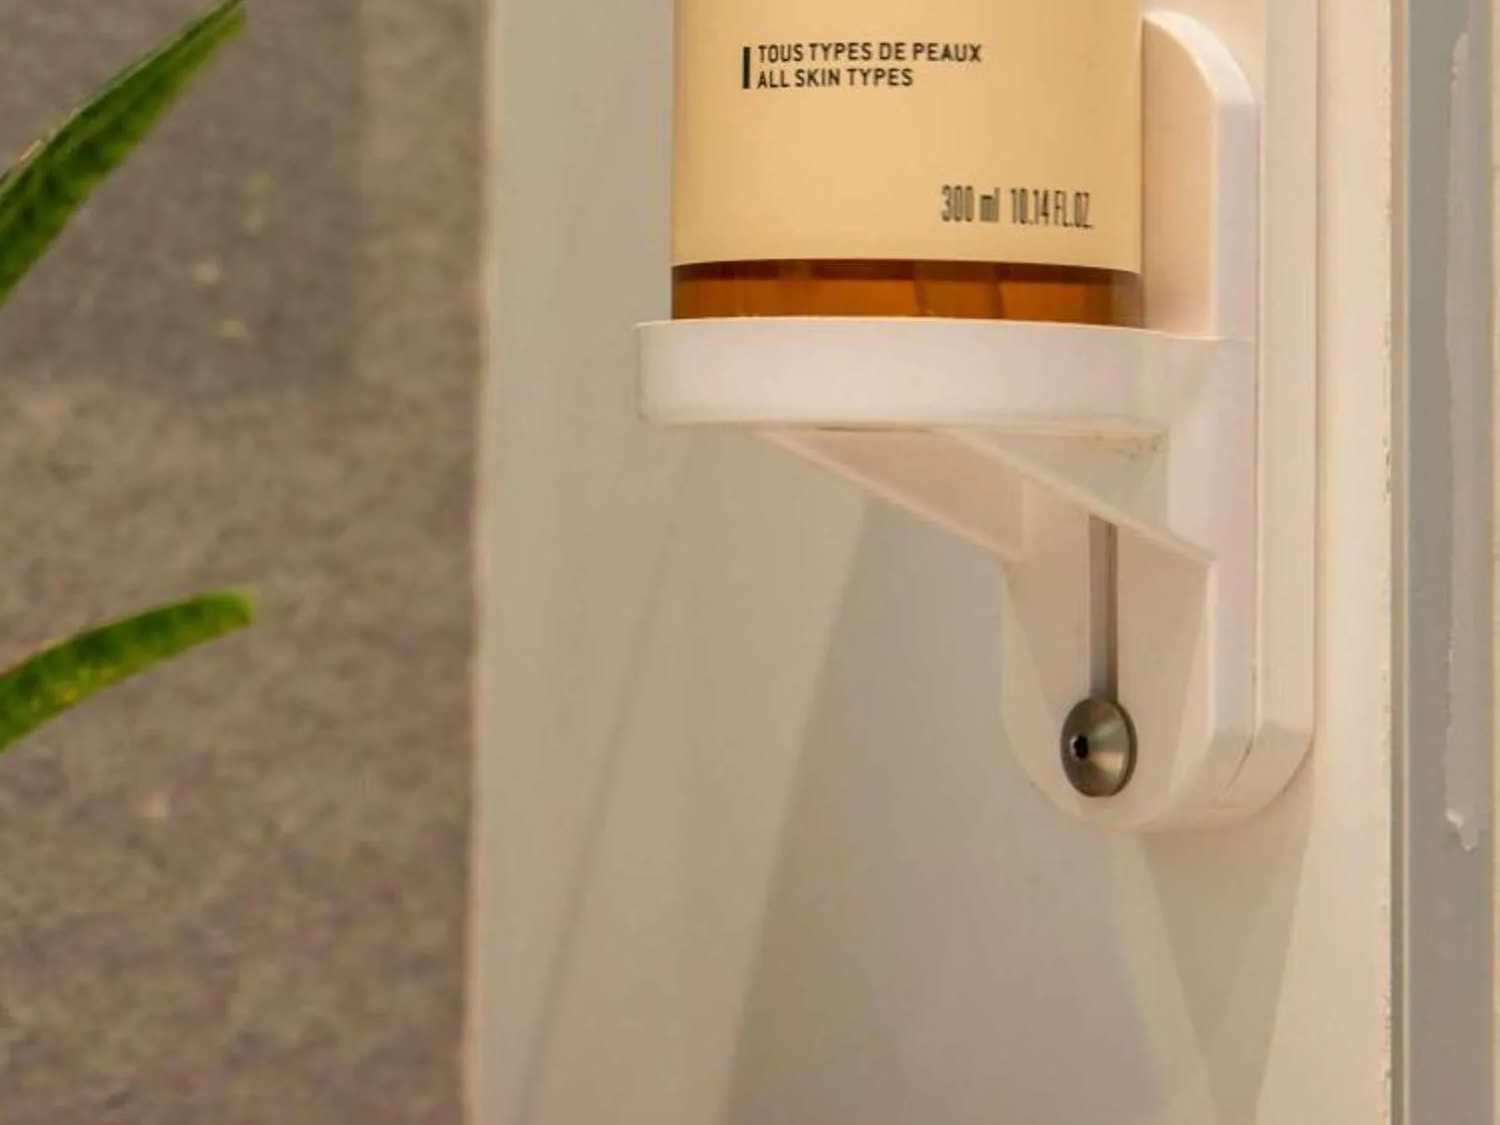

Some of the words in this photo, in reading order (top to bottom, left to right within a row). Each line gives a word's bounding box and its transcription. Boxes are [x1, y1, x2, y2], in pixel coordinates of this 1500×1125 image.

[758, 43, 803, 63] TOUS
[809, 42, 872, 61] TYPES
[879, 42, 905, 61] DE
[913, 43, 981, 62] PEAUX
[757, 70, 789, 88] ALL
[795, 69, 840, 87] SKIN
[847, 68, 913, 86] TYPES
[942, 185, 974, 222] 300
[980, 187, 1000, 222] ml
